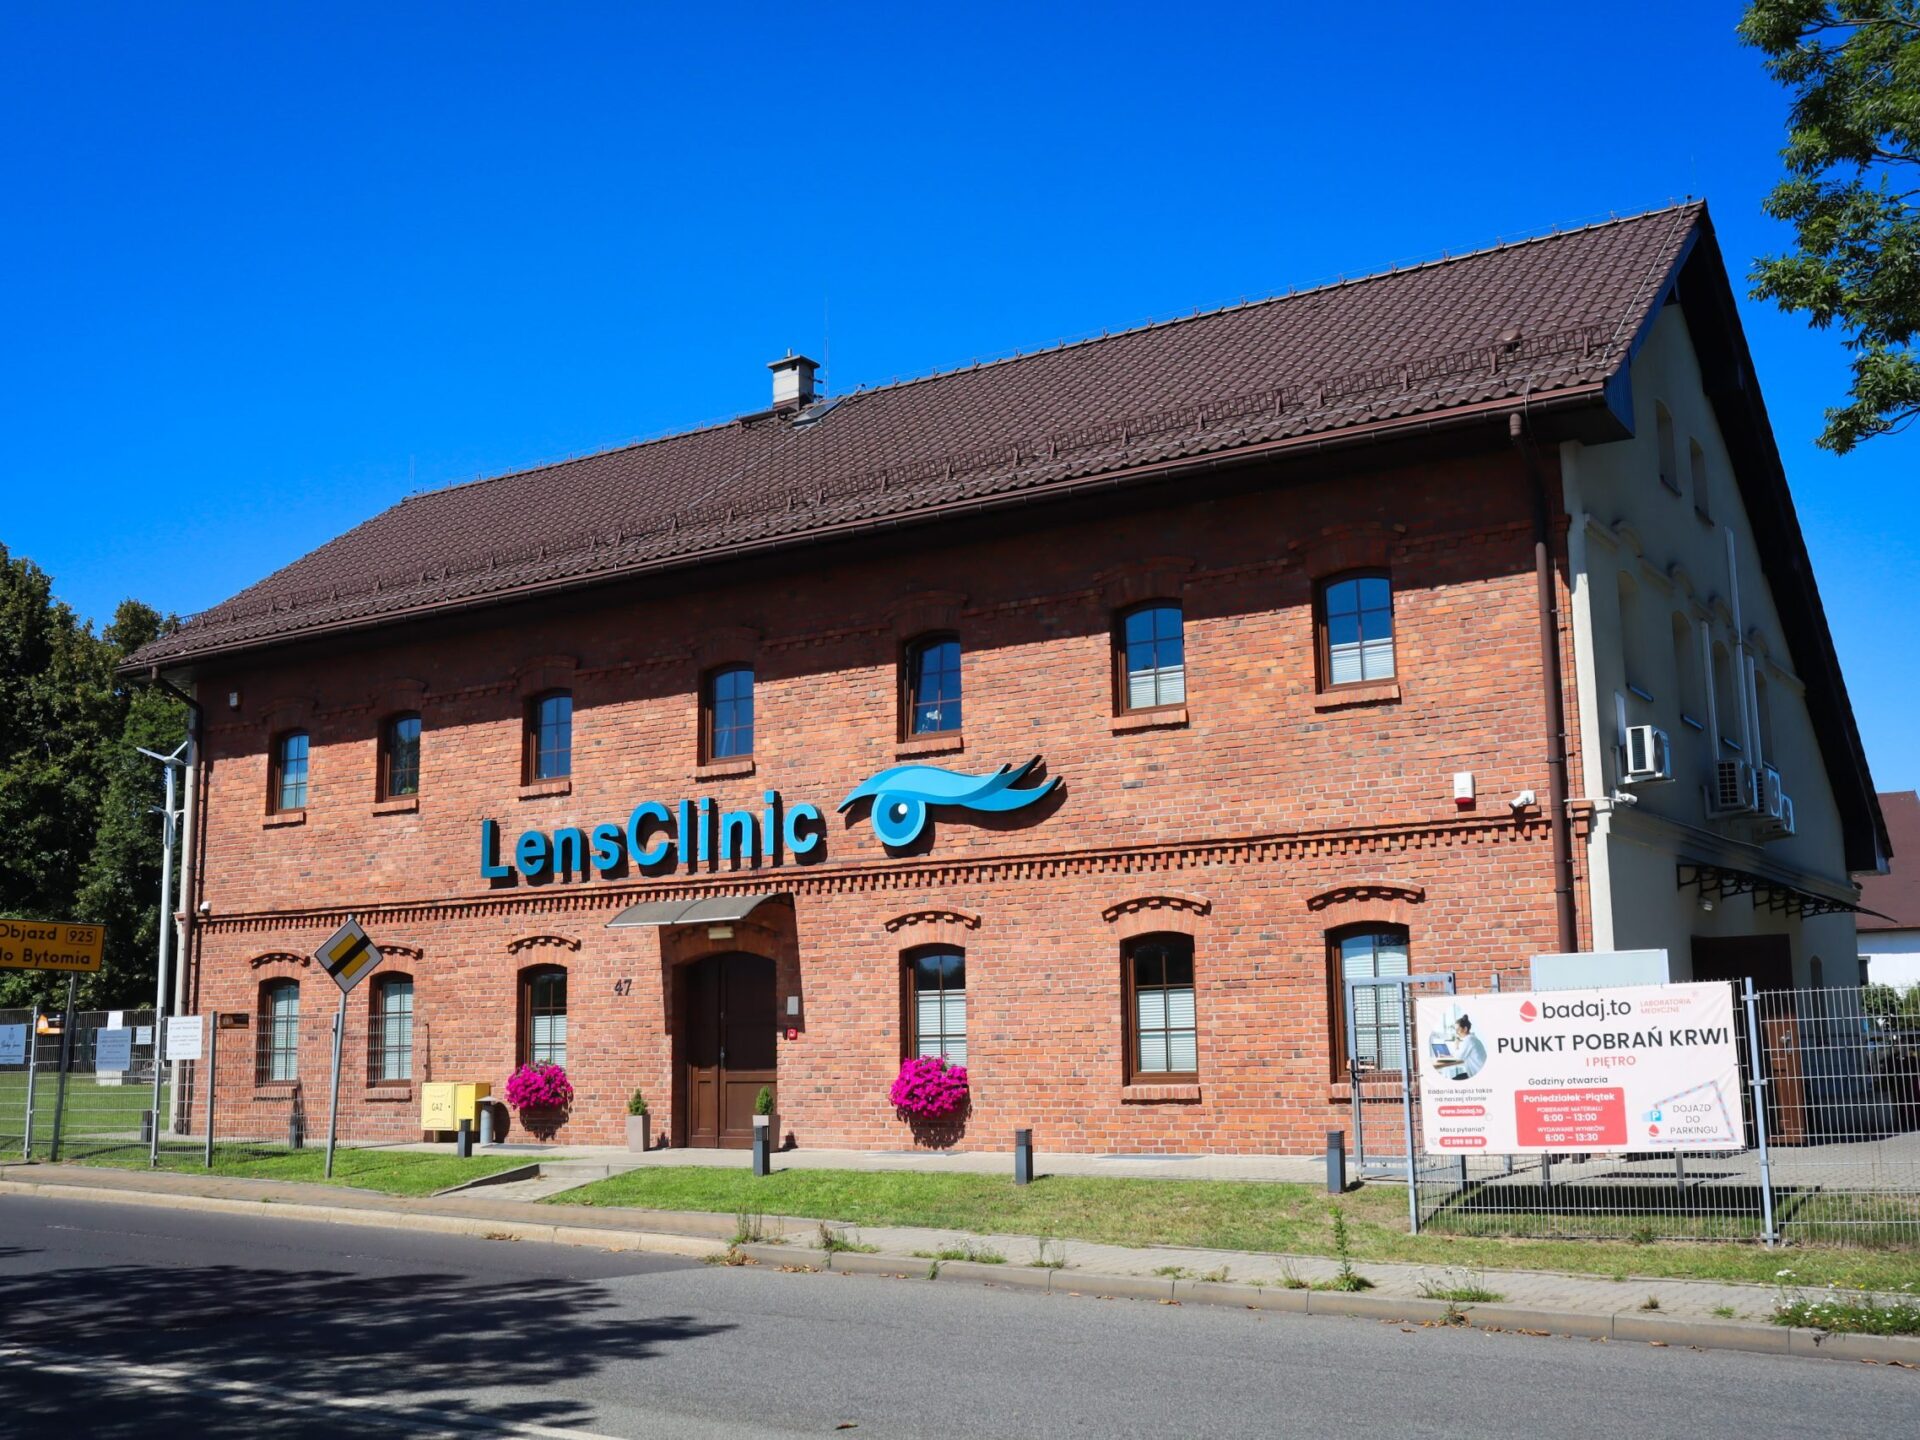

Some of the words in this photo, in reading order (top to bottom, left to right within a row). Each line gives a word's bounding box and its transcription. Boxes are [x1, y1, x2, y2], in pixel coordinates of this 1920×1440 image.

[481, 790, 819, 878] LensClinic
[0, 923, 57, 942] Objazd
[69, 930, 93, 942] 925
[0, 947, 13, 961] o
[23, 948, 90, 966] Bytomia
[614, 979, 632, 996] 47
[1640, 998, 1691, 1008] LABORATORIA
[1542, 999, 1631, 1021] badaj.to
[1640, 1005, 1680, 1014] MEDYCZNE
[1498, 1035, 1566, 1053] PUNKT
[1573, 1026, 1663, 1050] POBRAŃ
[1669, 1027, 1729, 1046] KRWI
[1586, 1057, 1590, 1067] I
[1593, 1055, 1636, 1068] PIĘTRO
[1528, 1077, 1565, 1086] Godziny
[1567, 1076, 1608, 1084] otwarcia
[431, 1103, 443, 1111] GAZ
[1673, 1104, 1711, 1113] DOJAZD
[1574, 1113, 1597, 1121] 13:00
[1652, 1111, 1659, 1120] P
[1685, 1115, 1701, 1123] DO
[1670, 1126, 1718, 1134] PARKINGU
[1575, 1133, 1598, 1141] 13:30
